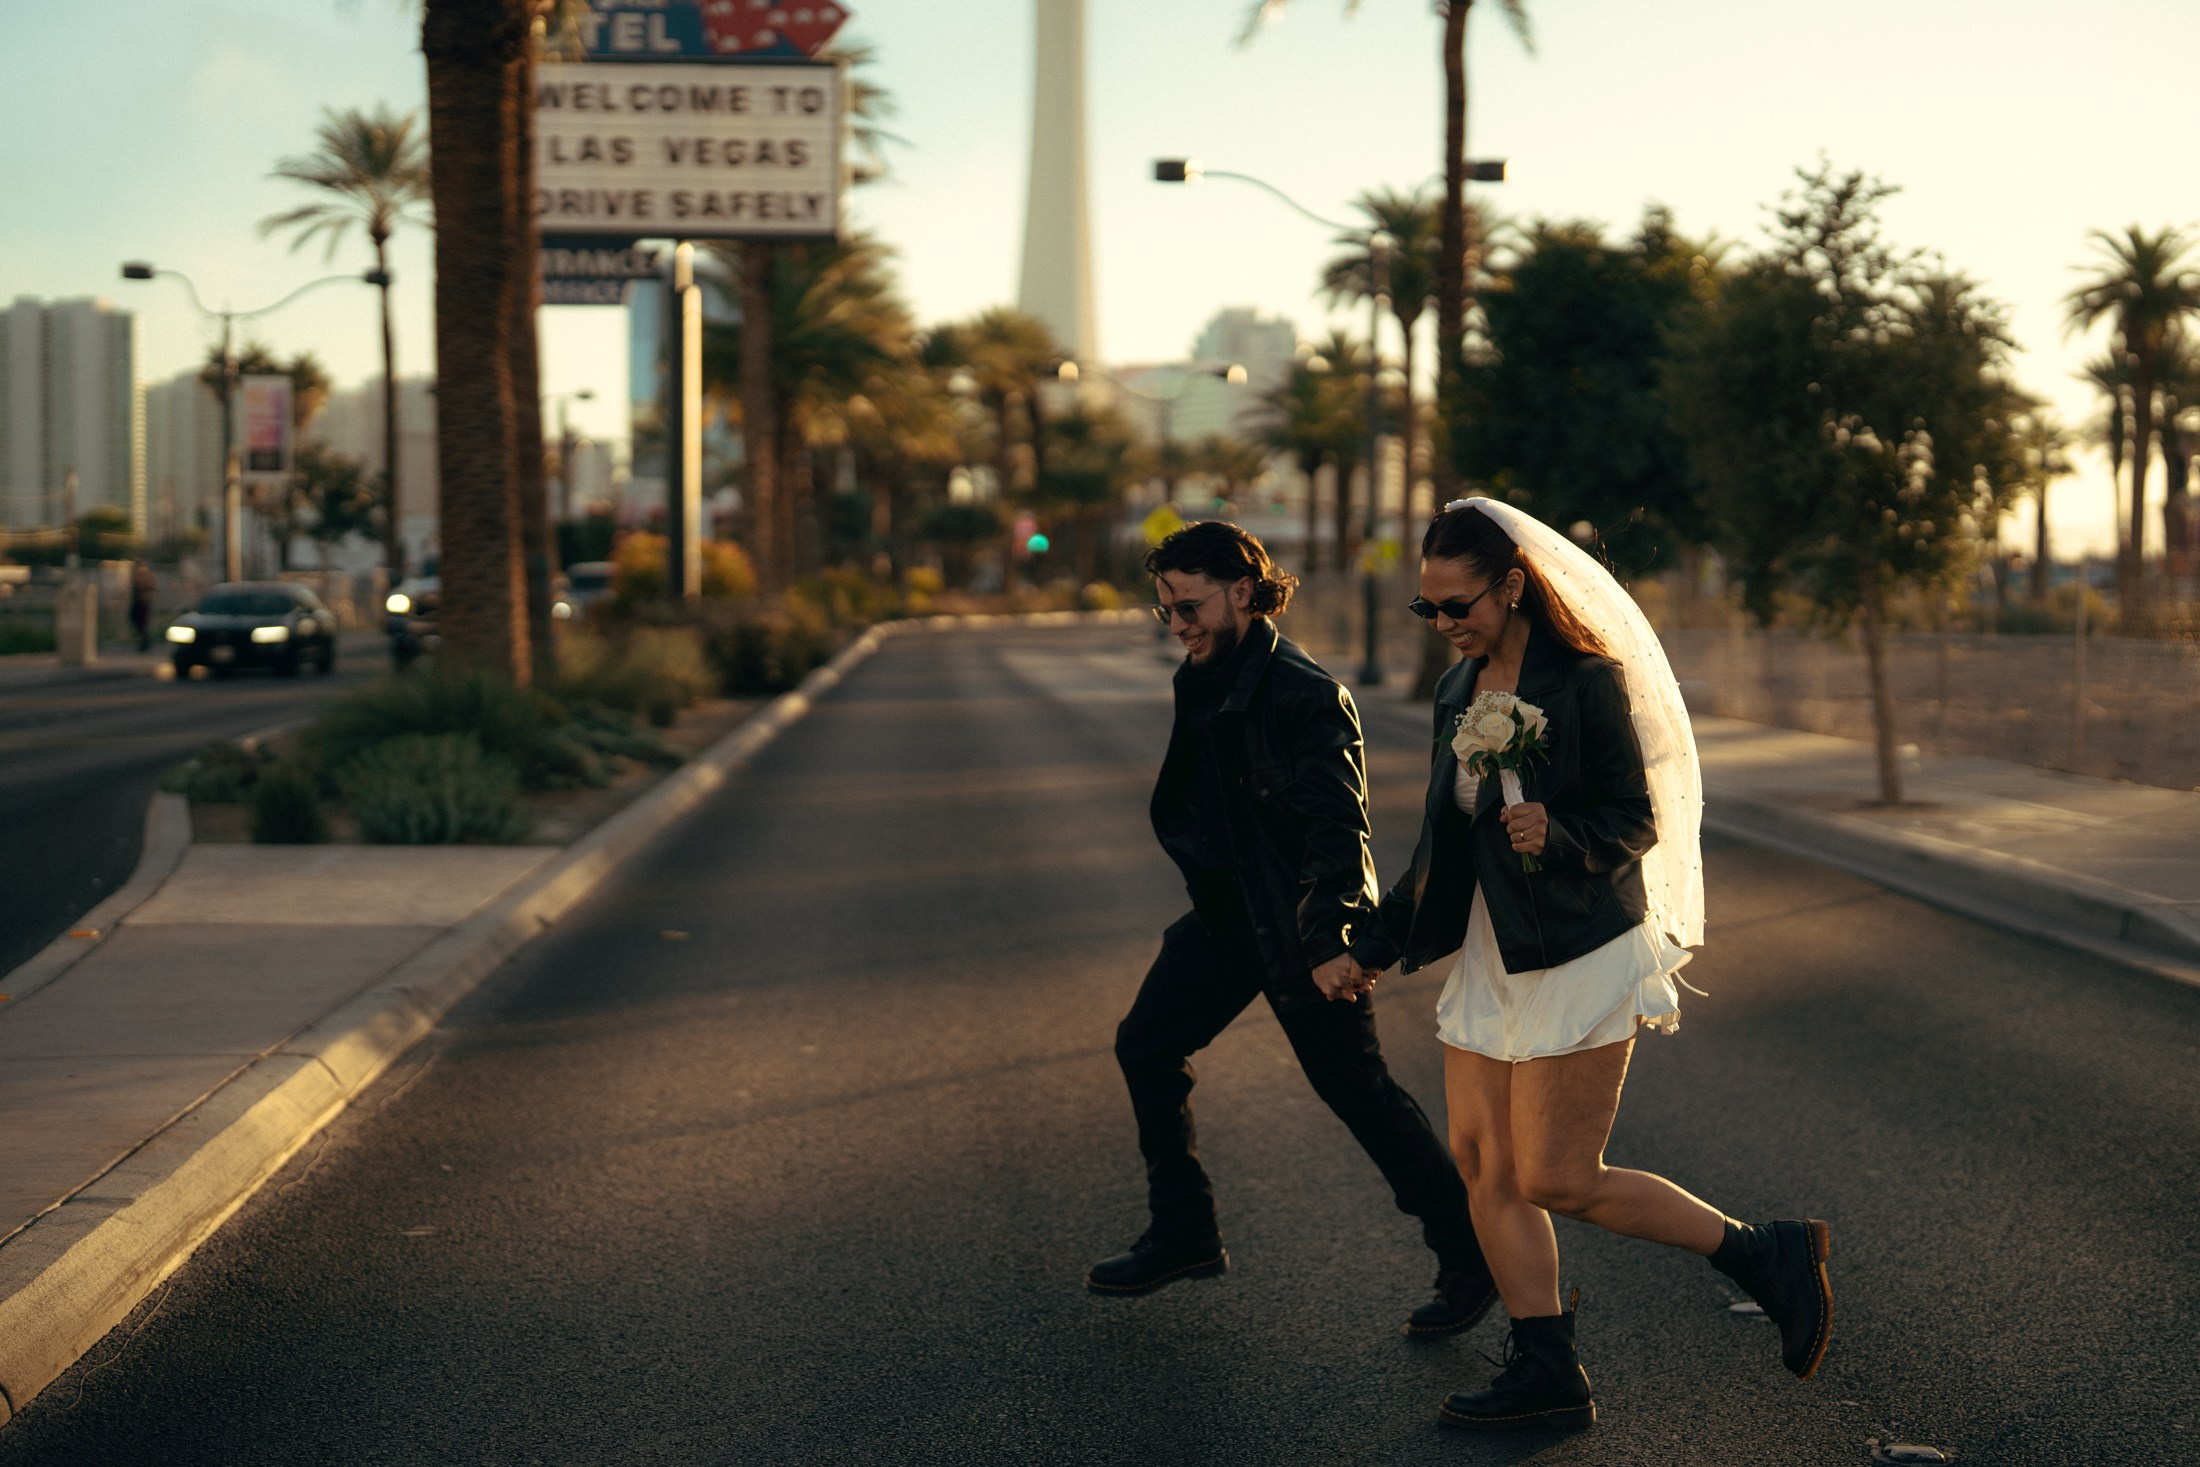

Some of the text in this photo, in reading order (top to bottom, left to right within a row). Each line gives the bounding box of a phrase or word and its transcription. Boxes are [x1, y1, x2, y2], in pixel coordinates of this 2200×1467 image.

[548, 11, 682, 51] TEL
[540, 83, 824, 113] WELCOME TO
[551, 134, 808, 166] LAS VEGAS
[538, 187, 821, 219] DRIVE SAFELY
